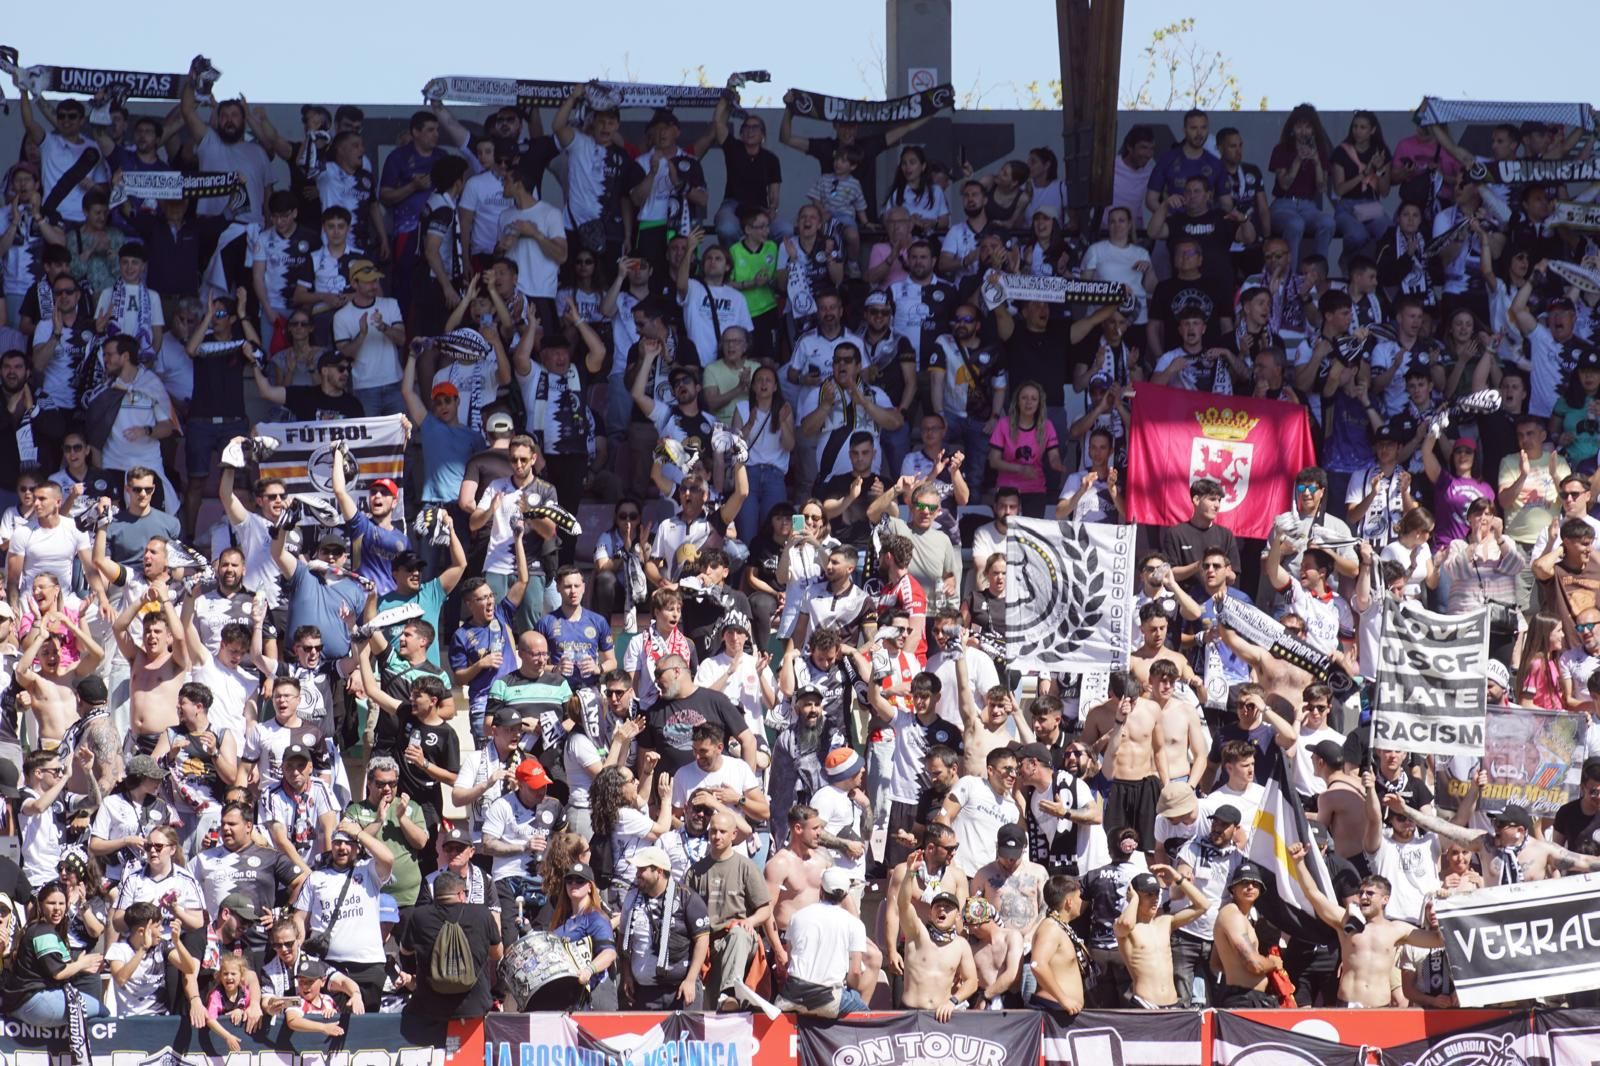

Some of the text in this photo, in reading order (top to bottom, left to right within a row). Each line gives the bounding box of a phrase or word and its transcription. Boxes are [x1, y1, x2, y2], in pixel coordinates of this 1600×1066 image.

[513, 83, 561, 98] Salamanca
[824, 94, 922, 122] UNIONISTAS
[180, 173, 226, 189] Salamanca
[1062, 278, 1109, 295] Salamanca
[127, 295, 139, 311] A
[285, 424, 373, 444] FÚTBOL
[1111, 525, 1128, 600] FONDO
[1385, 609, 1481, 642] LOVE
[1276, 630, 1322, 664] Salamanca
[1382, 643, 1481, 673] USCF
[1380, 681, 1480, 709] HATE
[1373, 719, 1483, 745] RACISM
[1448, 779, 1521, 800] Coando
[320, 899, 330, 911] La
[92, 1021, 117, 1040] CF
[832, 1036, 895, 1066] ON
[895, 1031, 1007, 1066] TOUR
[1443, 1040, 1486, 1057] GUARDIA
